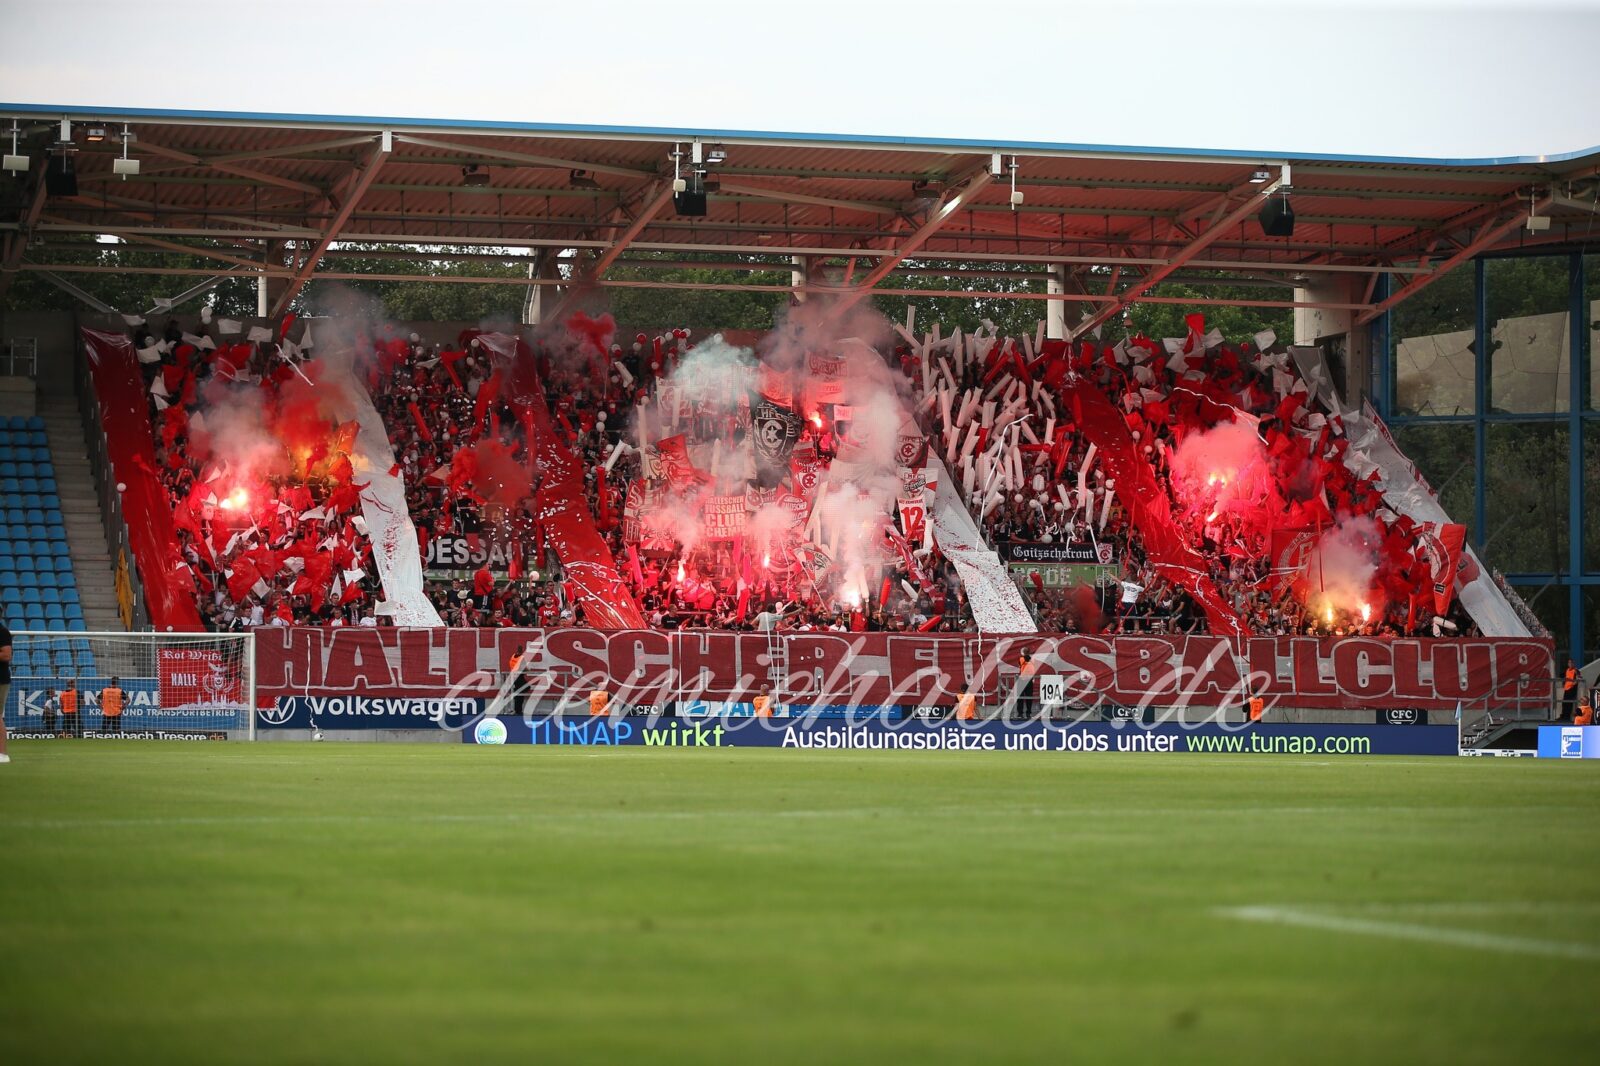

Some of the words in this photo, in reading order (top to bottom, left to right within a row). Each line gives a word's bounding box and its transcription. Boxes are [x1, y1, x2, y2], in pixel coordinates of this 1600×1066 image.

[705, 504, 745, 514] FUSSBALL
[705, 513, 746, 527] CLUB
[901, 507, 923, 531] 12
[162, 650, 185, 660] Rot
[252, 627, 853, 696] HALLESCHER
[887, 635, 1553, 699] FUSSBALLCLUB
[171, 673, 197, 686] HALLE
[1041, 683, 1062, 700] 19A
[310, 697, 478, 721] Volkswagen
[636, 705, 659, 715] CFC
[918, 706, 940, 717] CFC
[1391, 709, 1413, 720] CFC
[525, 721, 632, 745] TUNAP
[782, 726, 995, 750] Ausbildungsplätze
[1004, 729, 1047, 751] und
[1056, 729, 1109, 752] Jobs
[1117, 733, 1179, 752] unter
[1186, 732, 1371, 755] www.tunap.com
